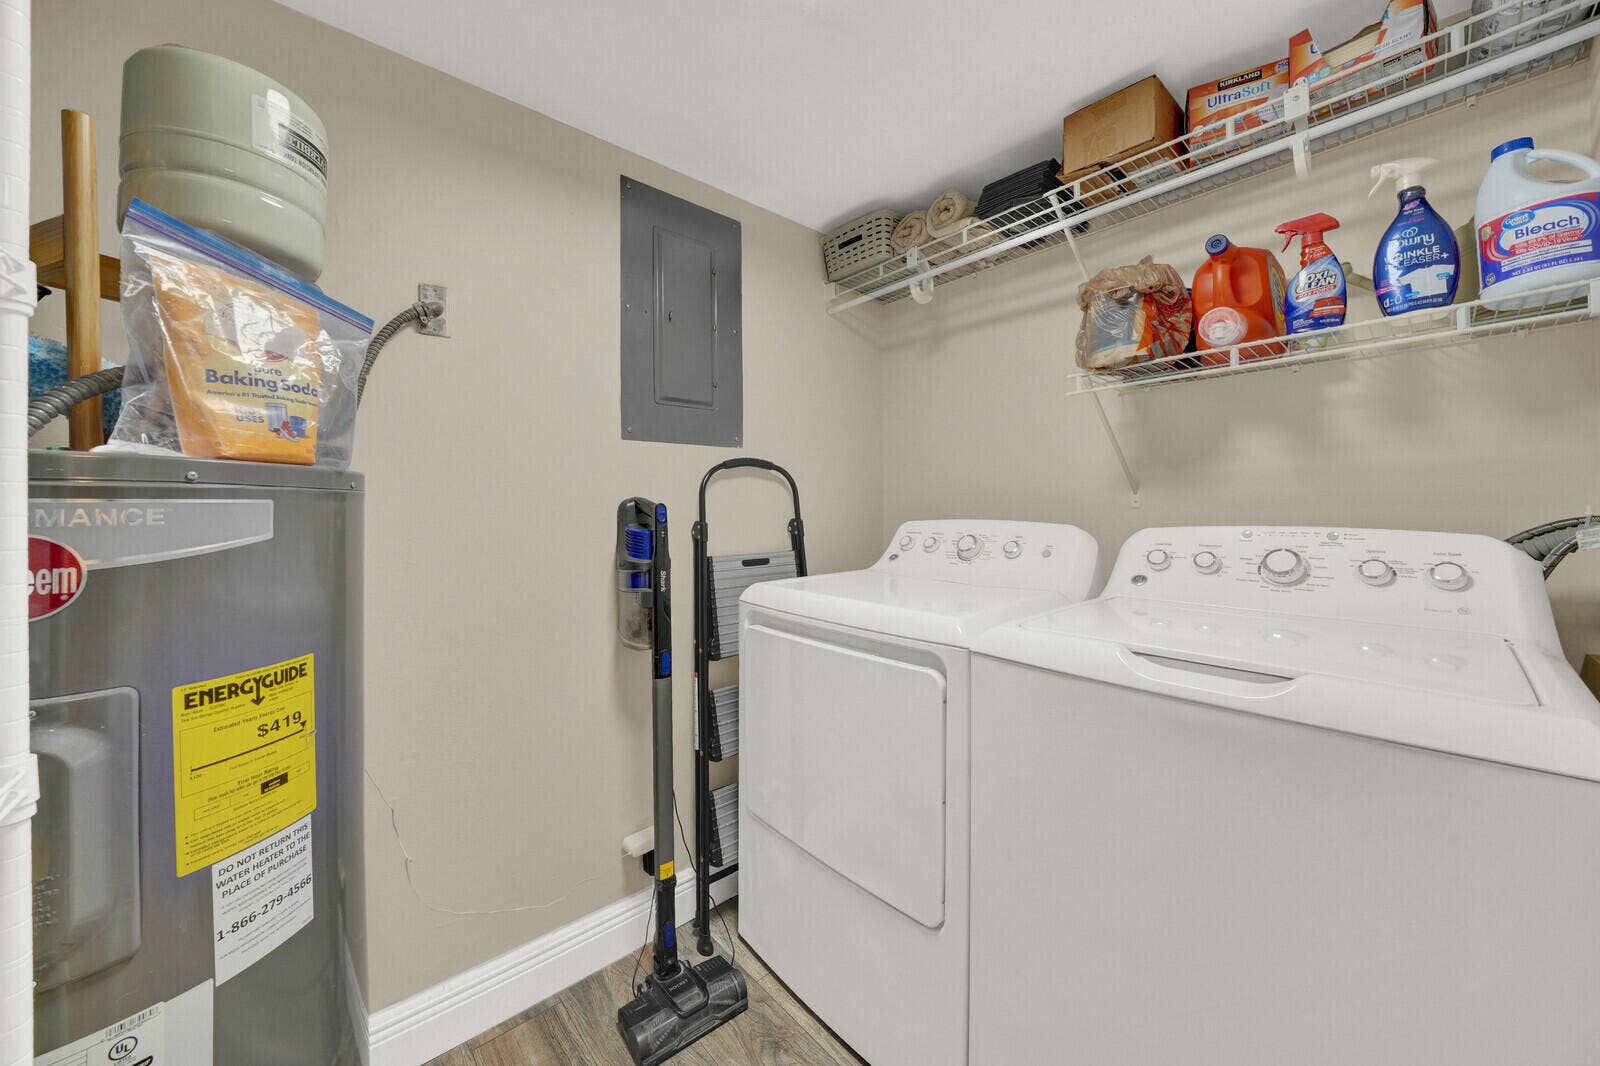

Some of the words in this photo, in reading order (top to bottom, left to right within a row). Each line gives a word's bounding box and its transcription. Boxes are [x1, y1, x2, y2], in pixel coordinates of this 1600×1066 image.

[1219, 70, 1261, 88] KIRKLAND
[1207, 80, 1272, 108] UltraSoft
[1514, 215, 1580, 240] Bleach
[205, 368, 279, 393] Baking
[280, 379, 319, 398] Soda
[236, 414, 265, 424] USES
[660, 569, 668, 593] Shark
[184, 662, 309, 711] ENERGYGUIDE
[256, 711, 302, 738] $419
[215, 867, 251, 890] WATER
[252, 848, 285, 871] HEATER
[285, 841, 297, 852] TO
[297, 832, 312, 846] THE
[217, 864, 234, 877] DO
[236, 852, 257, 868] NOT
[258, 835, 292, 857] RETURN
[292, 822, 309, 837] THIS
[221, 879, 252, 899] PLACE
[252, 870, 267, 882] OF
[267, 844, 307, 874] PURCHASE
[216, 873, 312, 943] 1-866-279-4566
